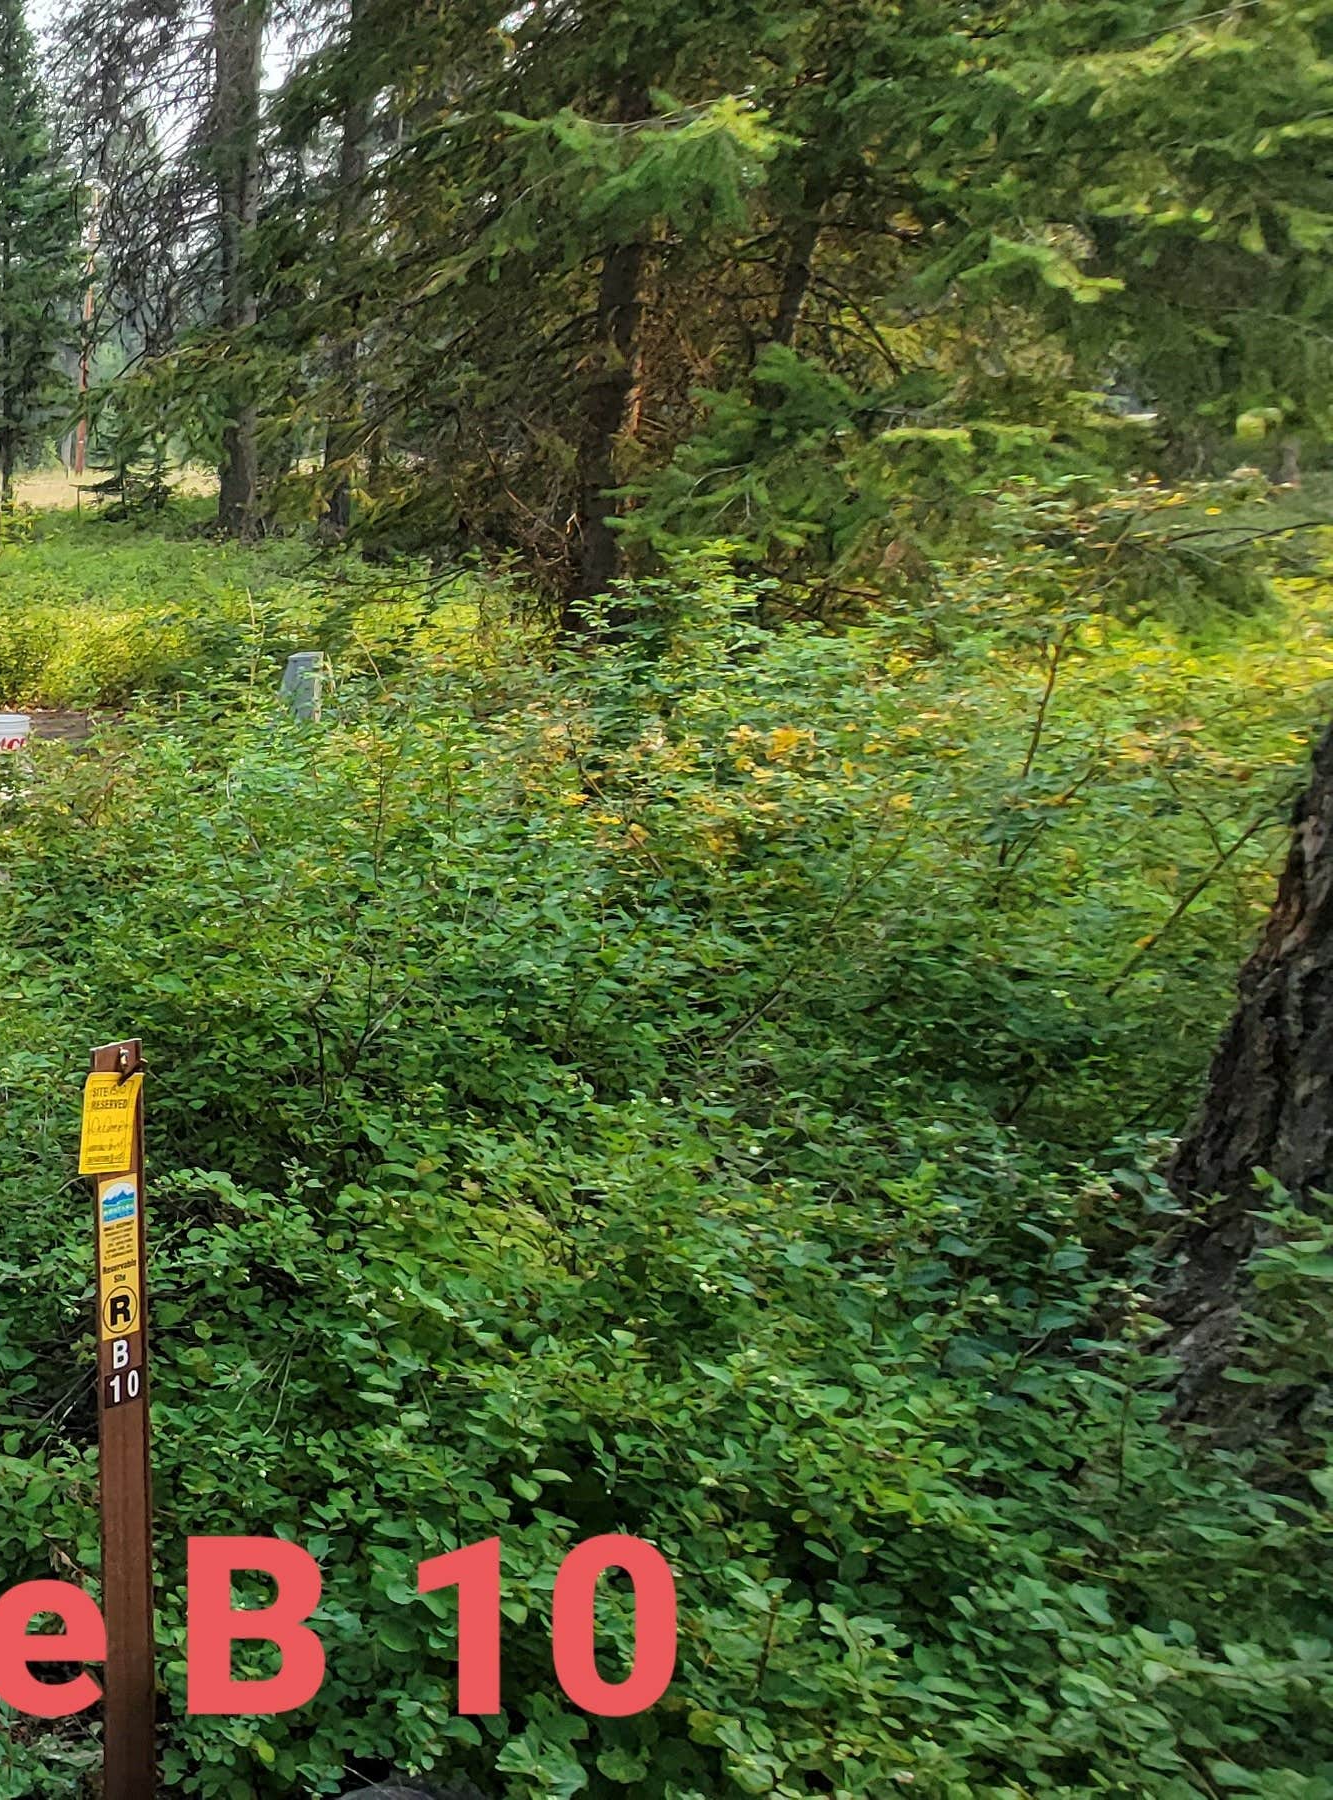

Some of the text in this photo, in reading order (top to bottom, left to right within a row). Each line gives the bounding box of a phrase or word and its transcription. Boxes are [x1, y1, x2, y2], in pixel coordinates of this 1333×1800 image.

[92, 1086, 109, 1098] SITE
[91, 1098, 128, 1110] RESERVED
[102, 1259, 137, 1275] Reservable
[113, 1273, 126, 1284] Site
[109, 1294, 131, 1326] R
[113, 1339, 130, 1370] B
[109, 1369, 139, 1404] 10
